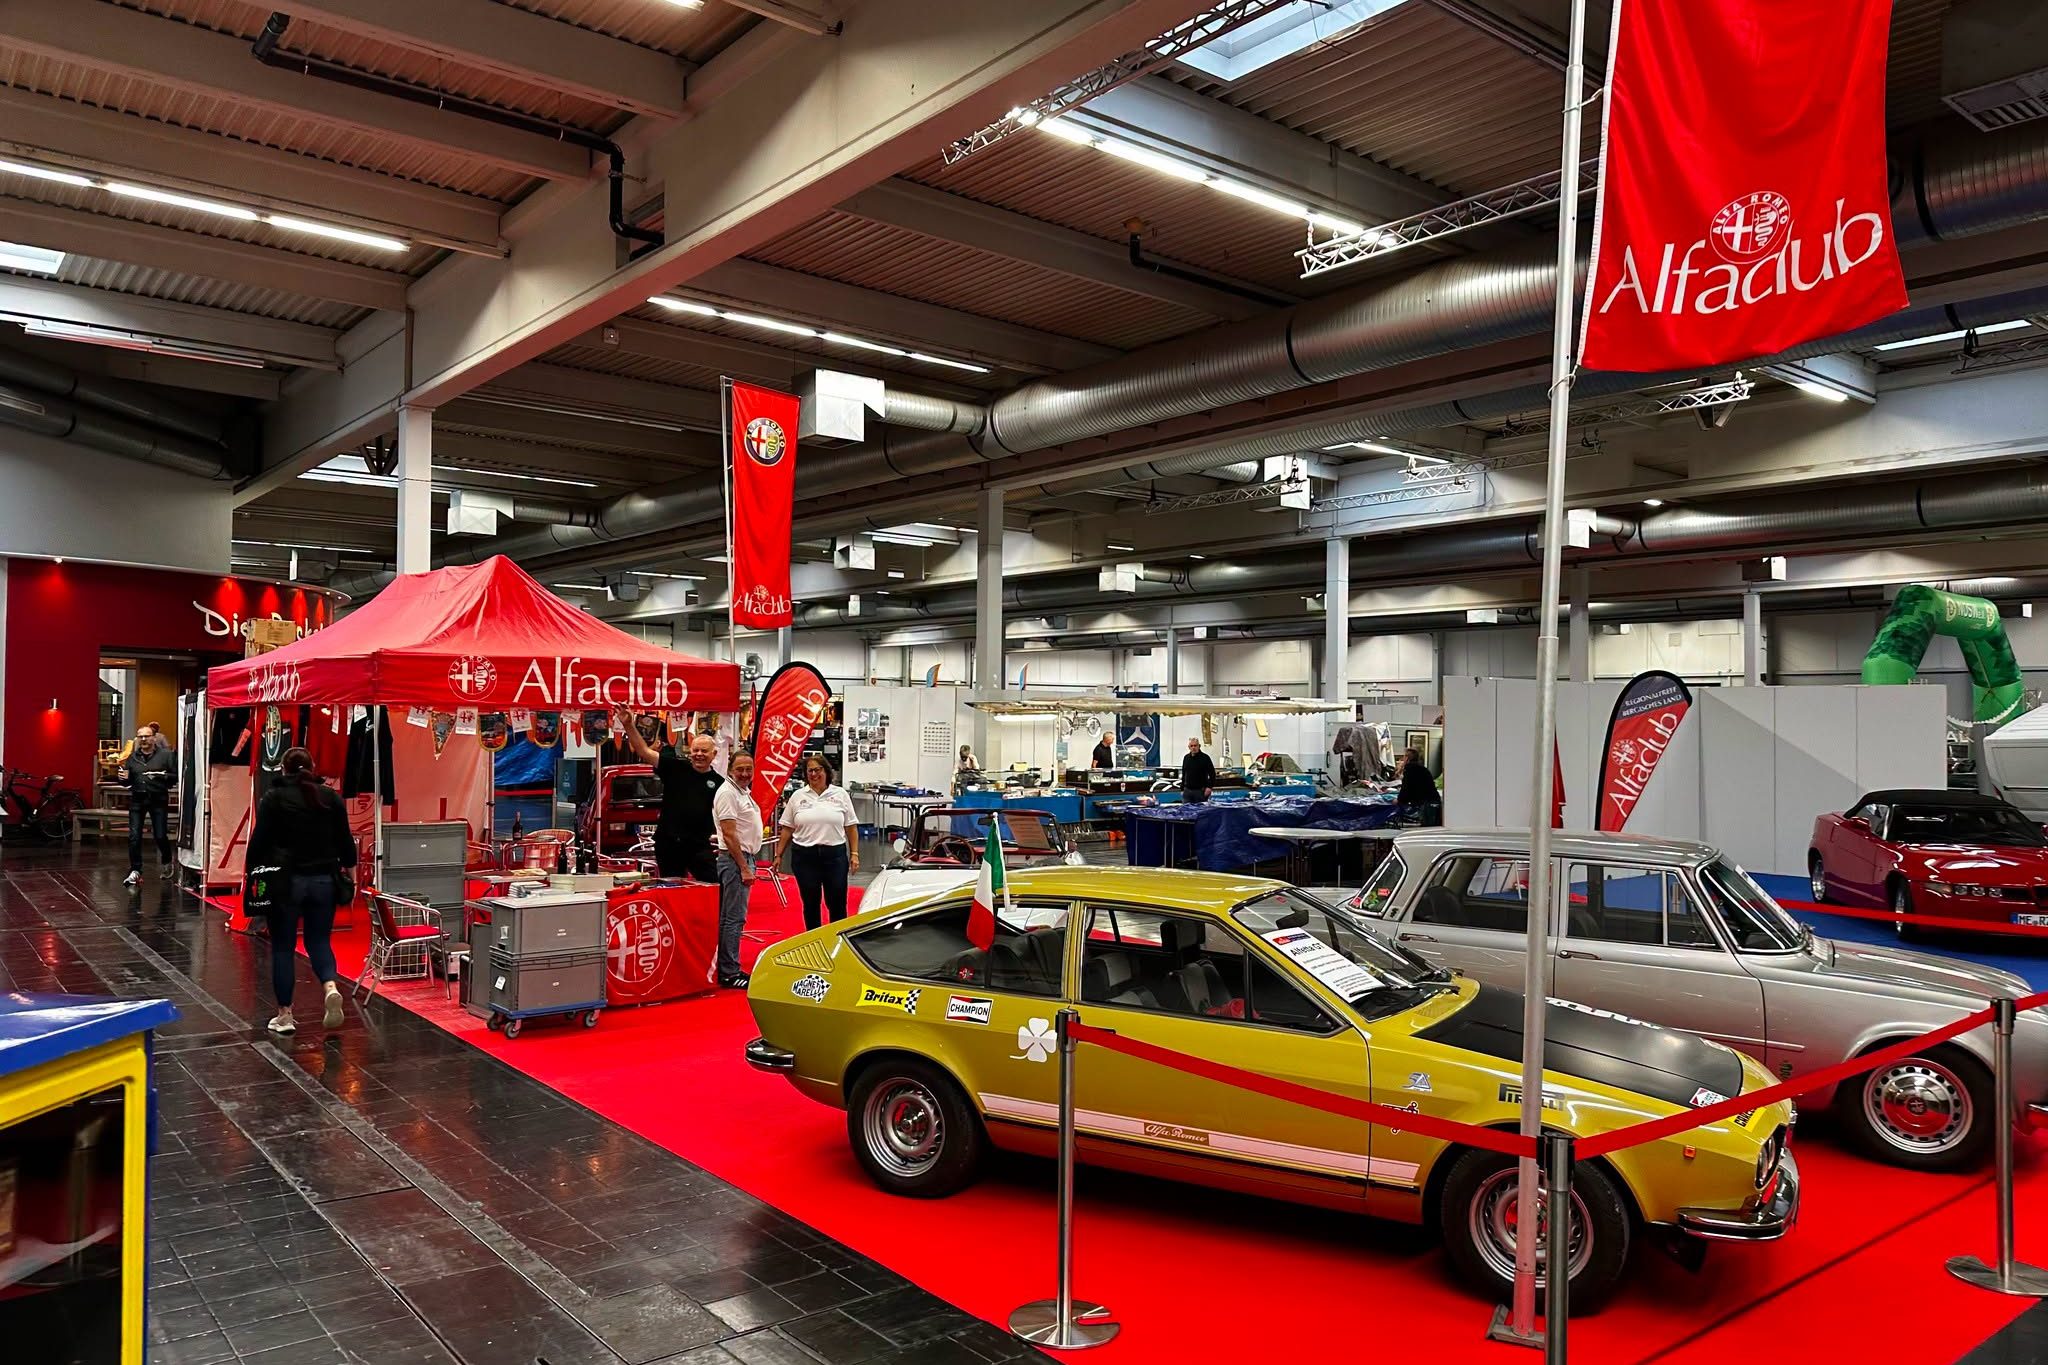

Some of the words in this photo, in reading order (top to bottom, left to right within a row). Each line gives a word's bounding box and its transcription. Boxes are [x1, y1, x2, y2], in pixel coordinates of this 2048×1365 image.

[1712, 203, 1743, 235] ALFA
[1750, 193, 1788, 225] ROMEO
[1599, 198, 1883, 315] Alfaclub
[512, 656, 689, 708] Alfaclub
[760, 688, 825, 794] Alfaclub
[1608, 712, 1679, 818] Alfaclub
[628, 903, 673, 947] ROMEO
[864, 989, 905, 1006] Britax
[950, 1003, 989, 1016] CHAMPION
[1145, 1124, 1170, 1137] Alfa
[1171, 1127, 1207, 1142] Romeo
